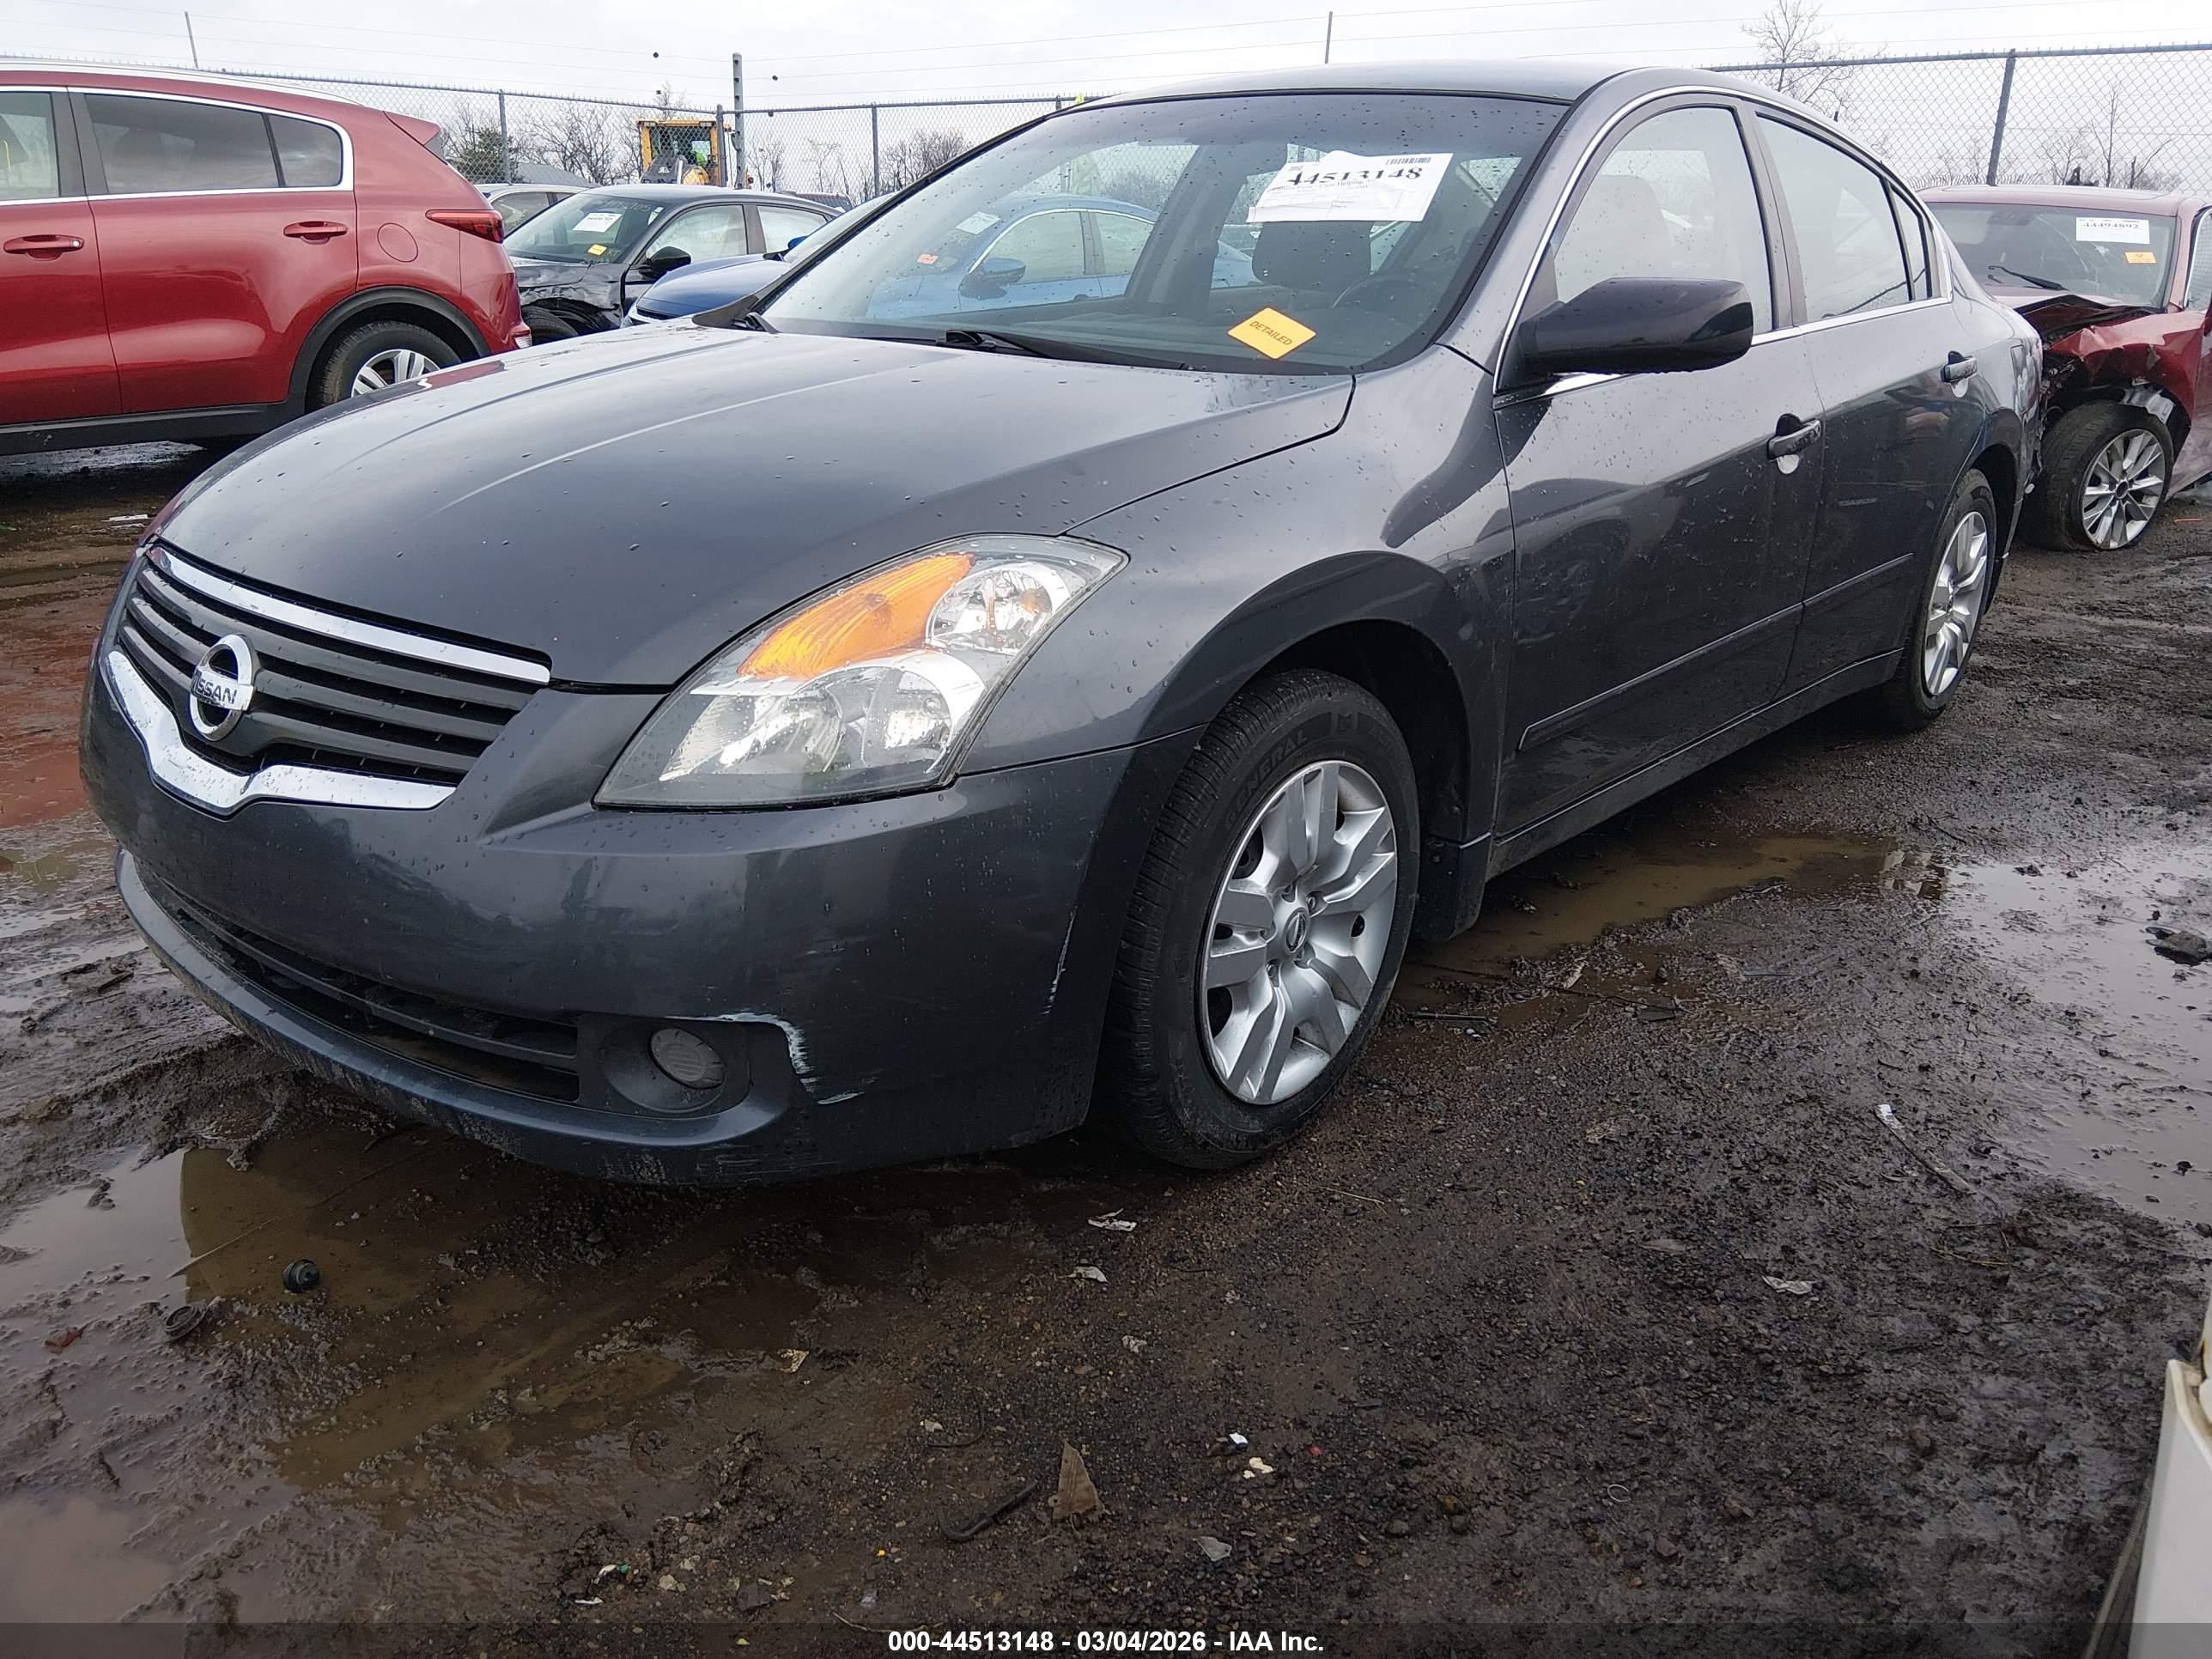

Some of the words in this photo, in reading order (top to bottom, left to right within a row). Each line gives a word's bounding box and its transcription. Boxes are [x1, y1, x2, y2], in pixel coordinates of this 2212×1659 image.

[1288, 167, 1423, 185] 44513148
[1249, 320, 1292, 346] DETAILED
[1226, 730, 1307, 830] GENERAL
